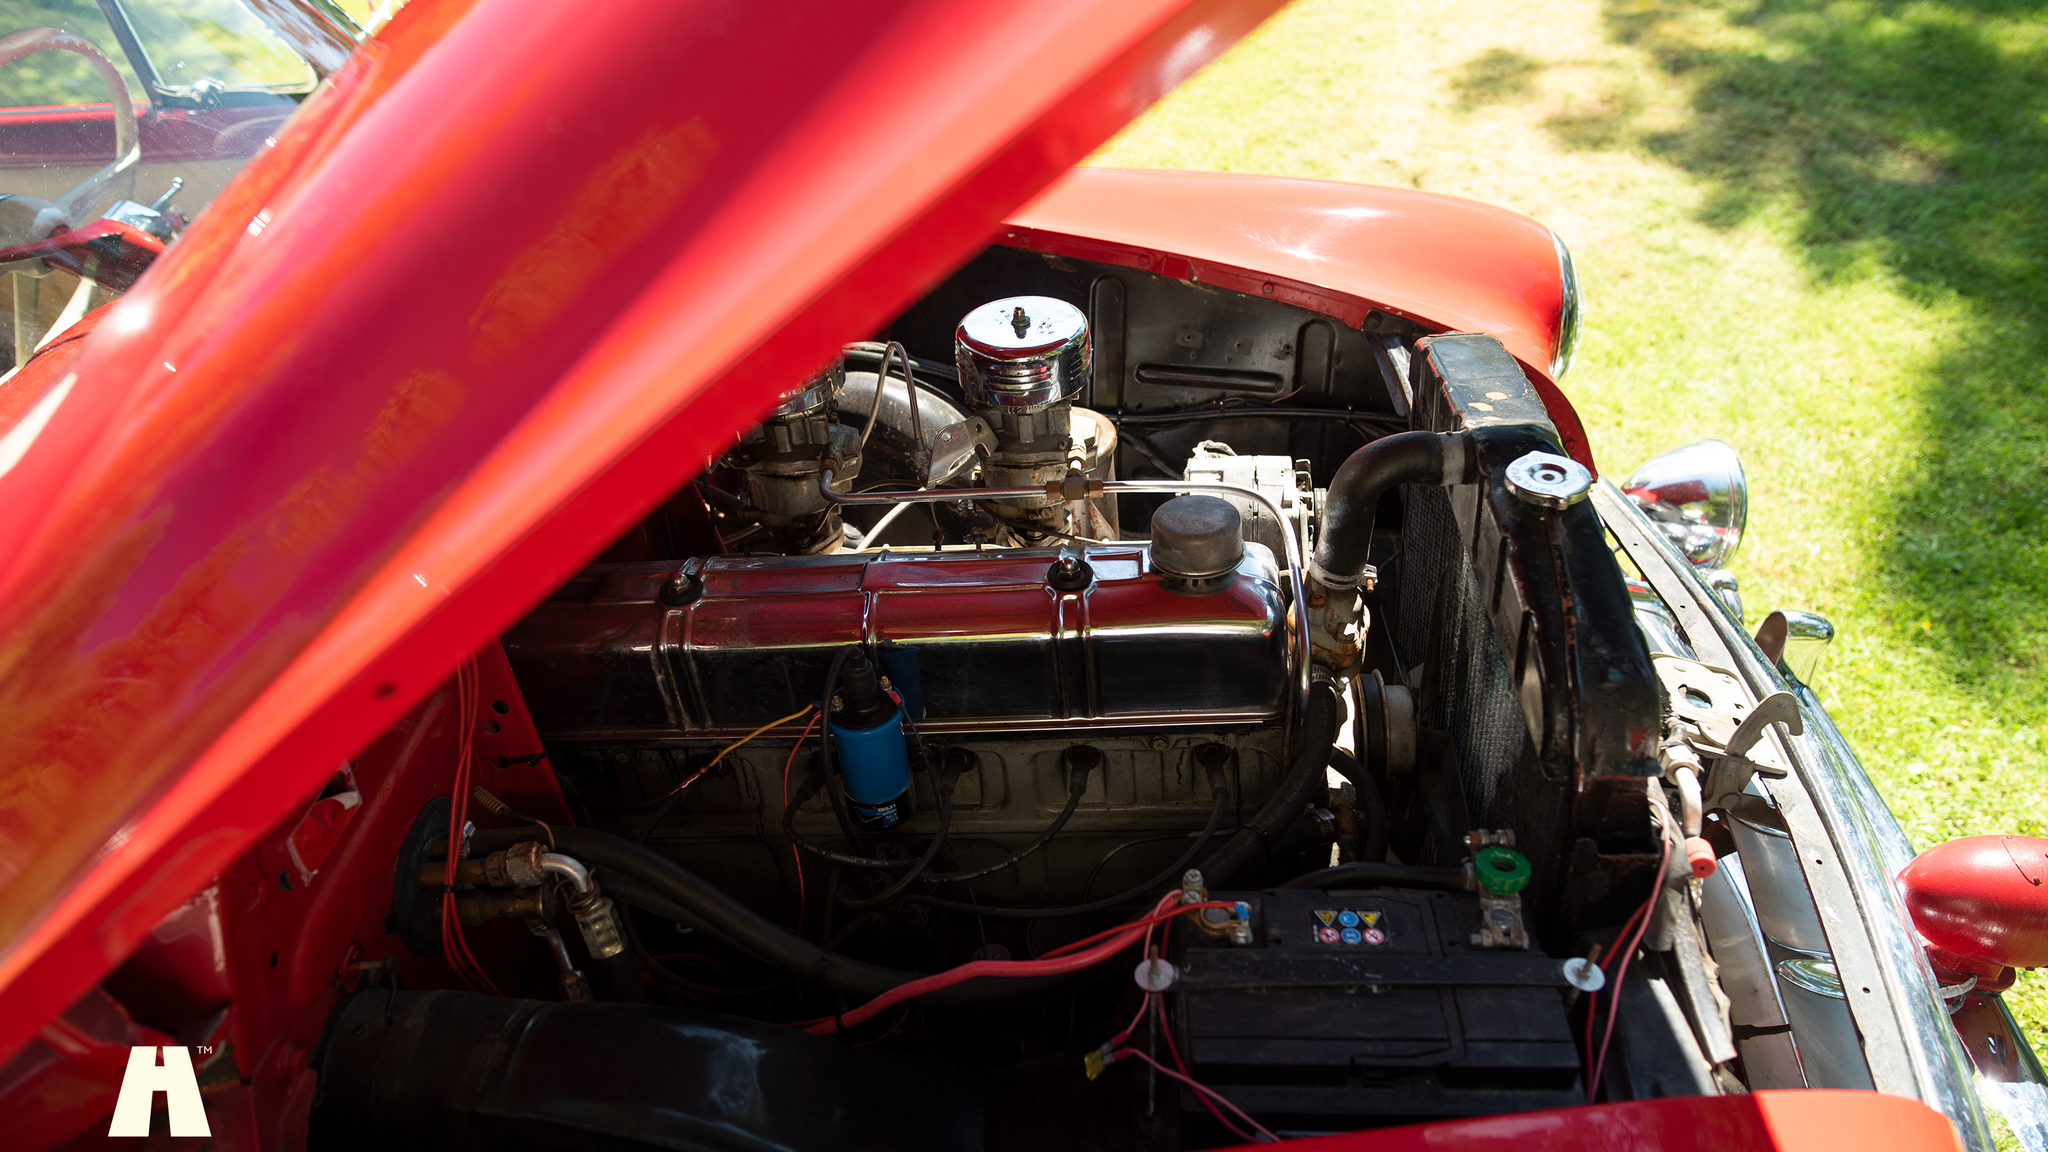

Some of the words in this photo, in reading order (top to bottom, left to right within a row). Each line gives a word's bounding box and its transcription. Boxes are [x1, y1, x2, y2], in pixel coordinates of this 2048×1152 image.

[830, 853, 857, 864] STANDARD
[952, 872, 979, 882] STANDARD
[991, 861, 1009, 872] TRIPLE
